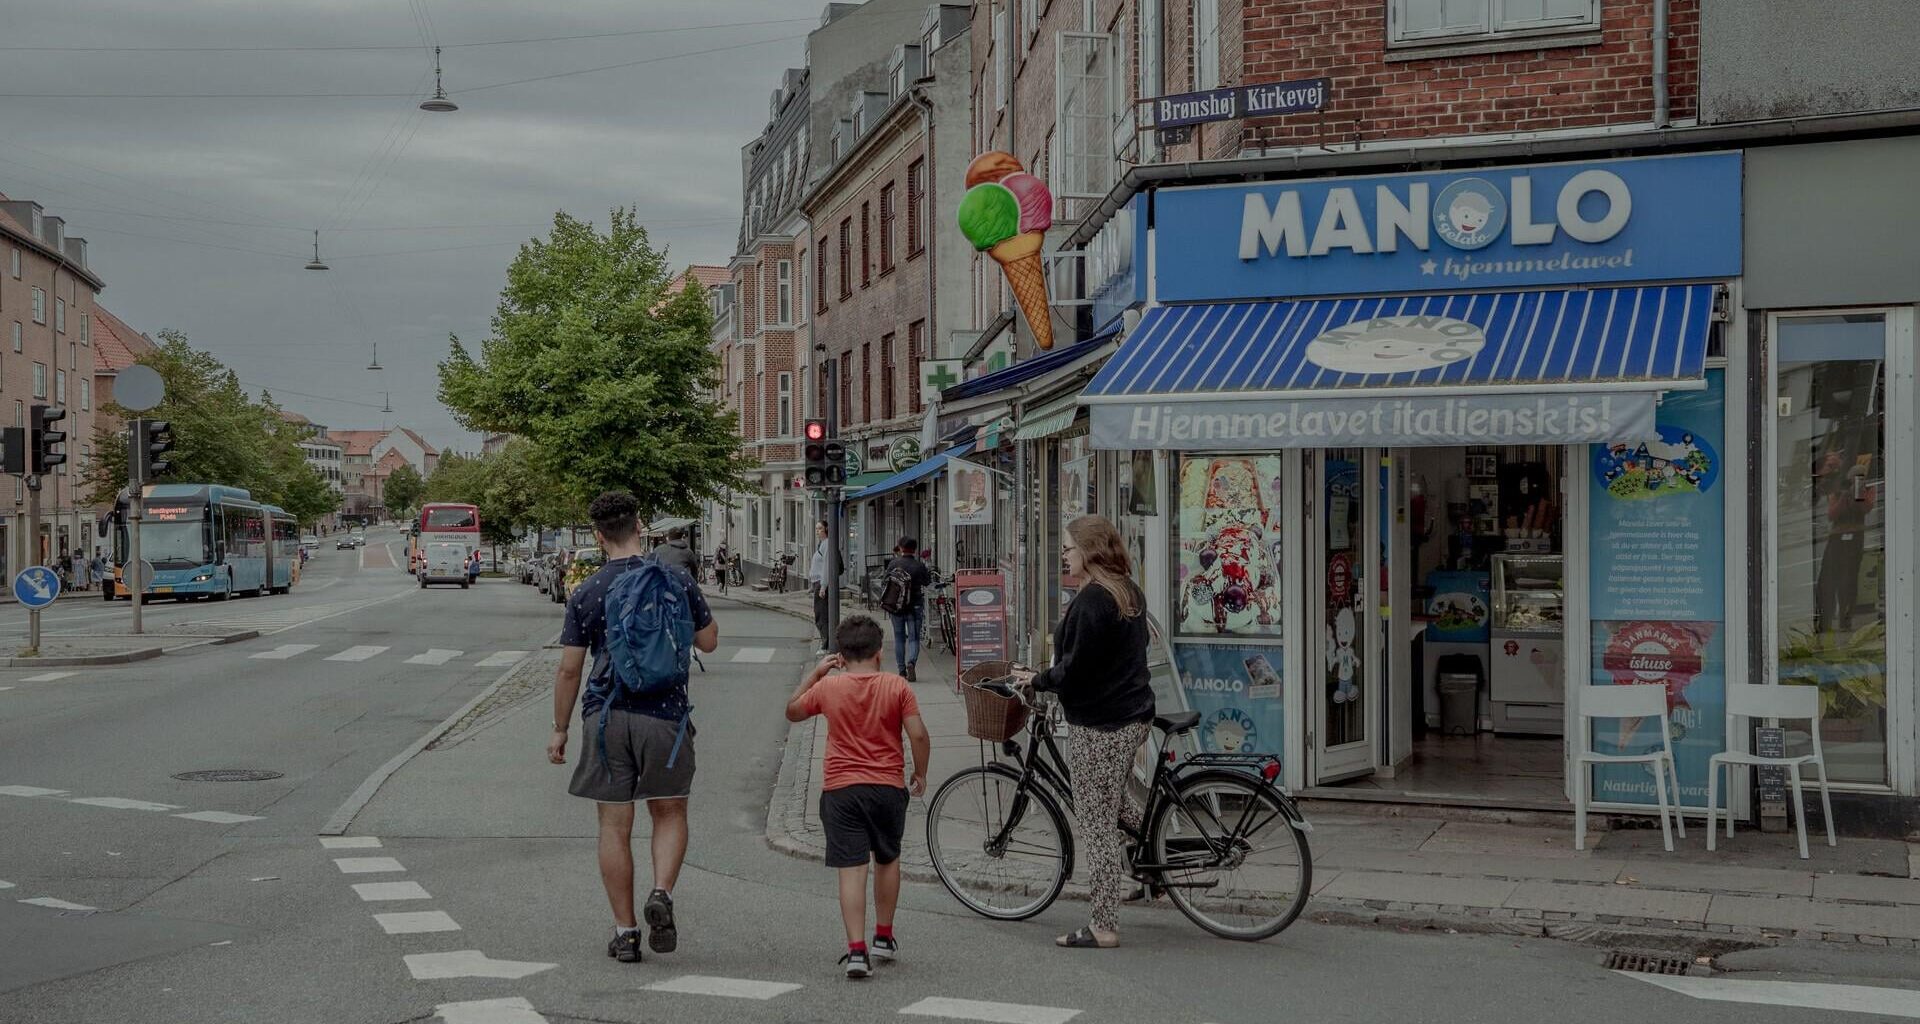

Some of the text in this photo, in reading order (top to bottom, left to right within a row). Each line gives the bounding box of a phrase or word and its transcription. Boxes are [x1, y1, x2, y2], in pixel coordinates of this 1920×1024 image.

[1160, 81, 1324, 122] Brønshøj Kirkevej
[1443, 249, 1634, 281] hjemmelavet
[1129, 396, 1612, 446] Hjemmelavet italiensk is!
[1623, 629, 1680, 650] DANMARKS
[1630, 656, 1673, 671] ishuse
[1182, 678, 1243, 692] MANOLO
